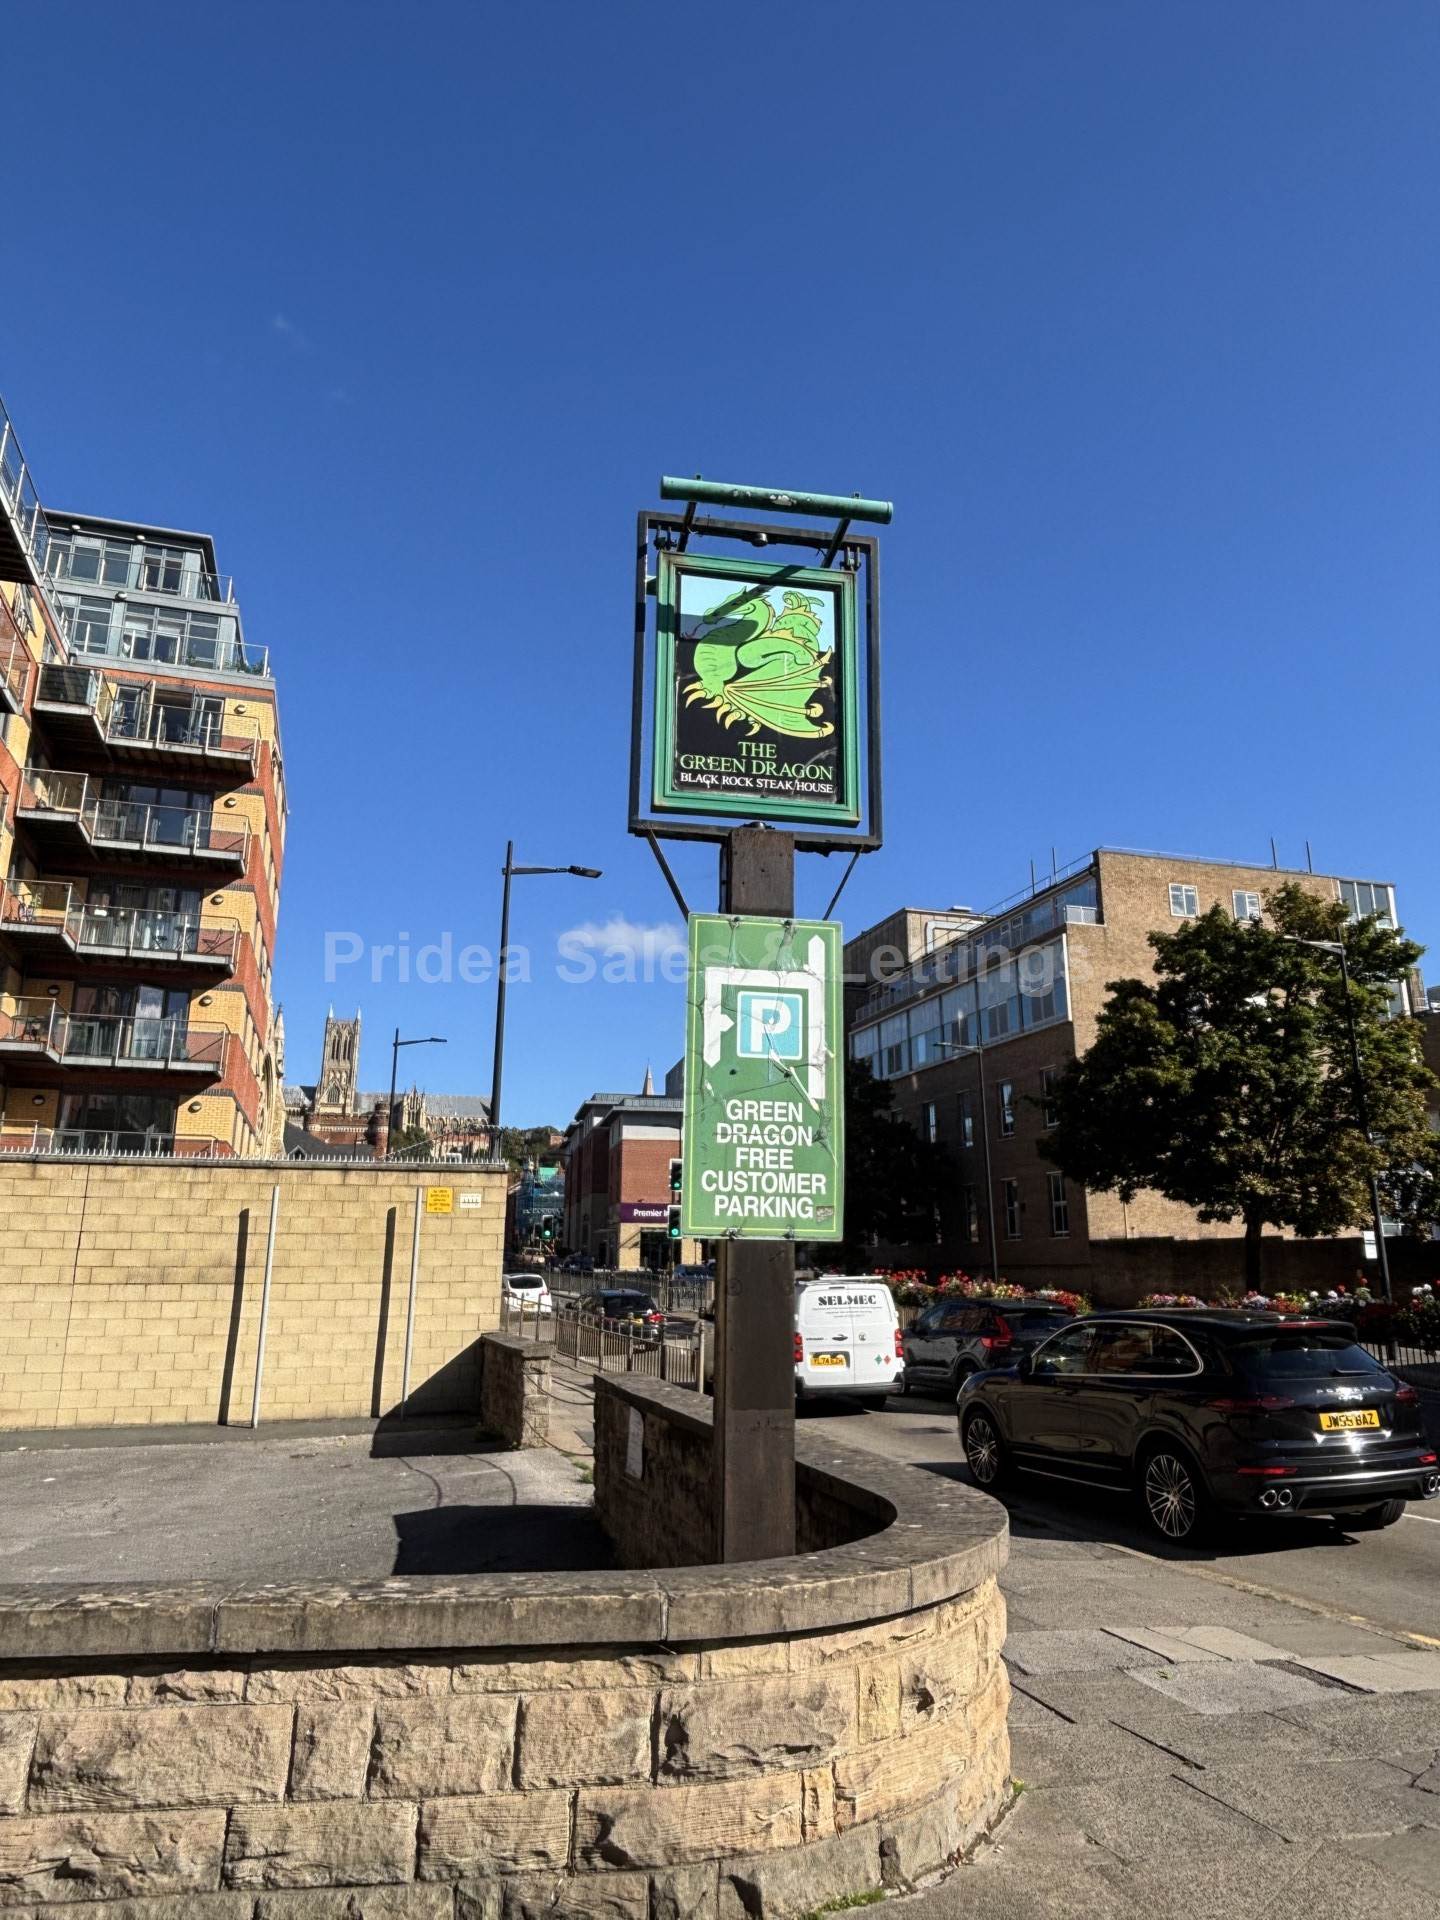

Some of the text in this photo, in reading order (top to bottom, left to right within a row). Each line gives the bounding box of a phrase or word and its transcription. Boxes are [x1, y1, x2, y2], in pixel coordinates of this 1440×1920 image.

[738, 741, 777, 758] THE
[680, 754, 834, 780] GREEN DRAGON
[680, 772, 834, 794] BLACK ROCK STEAK HOUSE
[751, 998, 791, 1054] P
[726, 1099, 803, 1122] GREEN
[716, 1122, 813, 1147] DRAGON
[735, 1147, 794, 1170] FREE
[701, 1170, 827, 1195] CUSTOMER
[633, 1208, 662, 1217] Premier
[714, 1195, 814, 1219] PARKING
[818, 1295, 877, 1306] SELMEC
